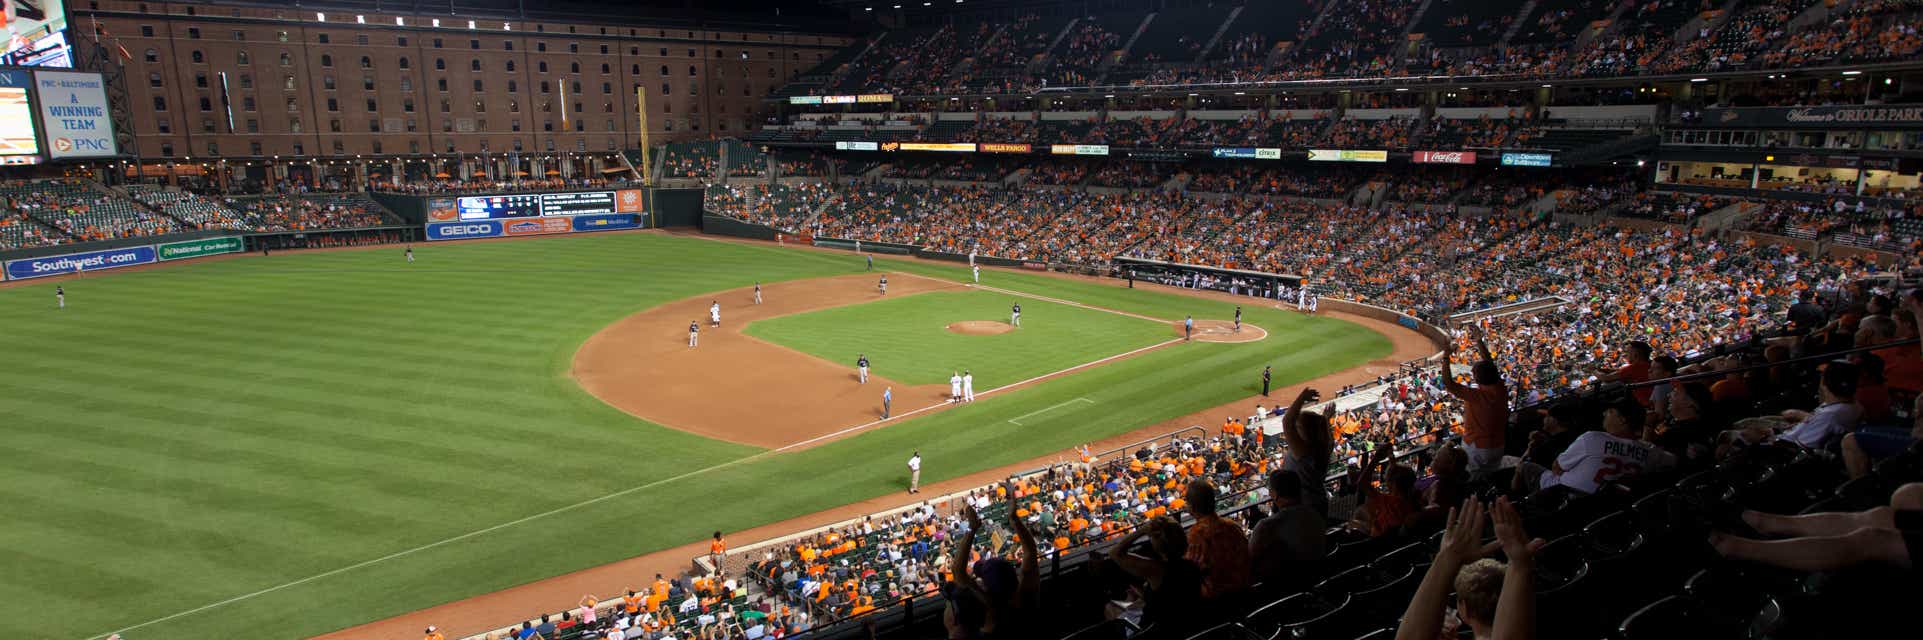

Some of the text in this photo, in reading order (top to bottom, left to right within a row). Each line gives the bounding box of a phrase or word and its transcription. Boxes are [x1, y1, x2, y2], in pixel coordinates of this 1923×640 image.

[70, 93, 78, 104] A
[49, 106, 103, 117] WINNING
[1835, 109, 1887, 121] ORIOLE
[62, 119, 96, 130] TEAM
[73, 138, 109, 150] PNC
[984, 144, 1027, 152] WELLS FARGO
[440, 224, 491, 236] GEICO
[172, 246, 202, 255] National
[1604, 441, 1648, 463] PALMER
